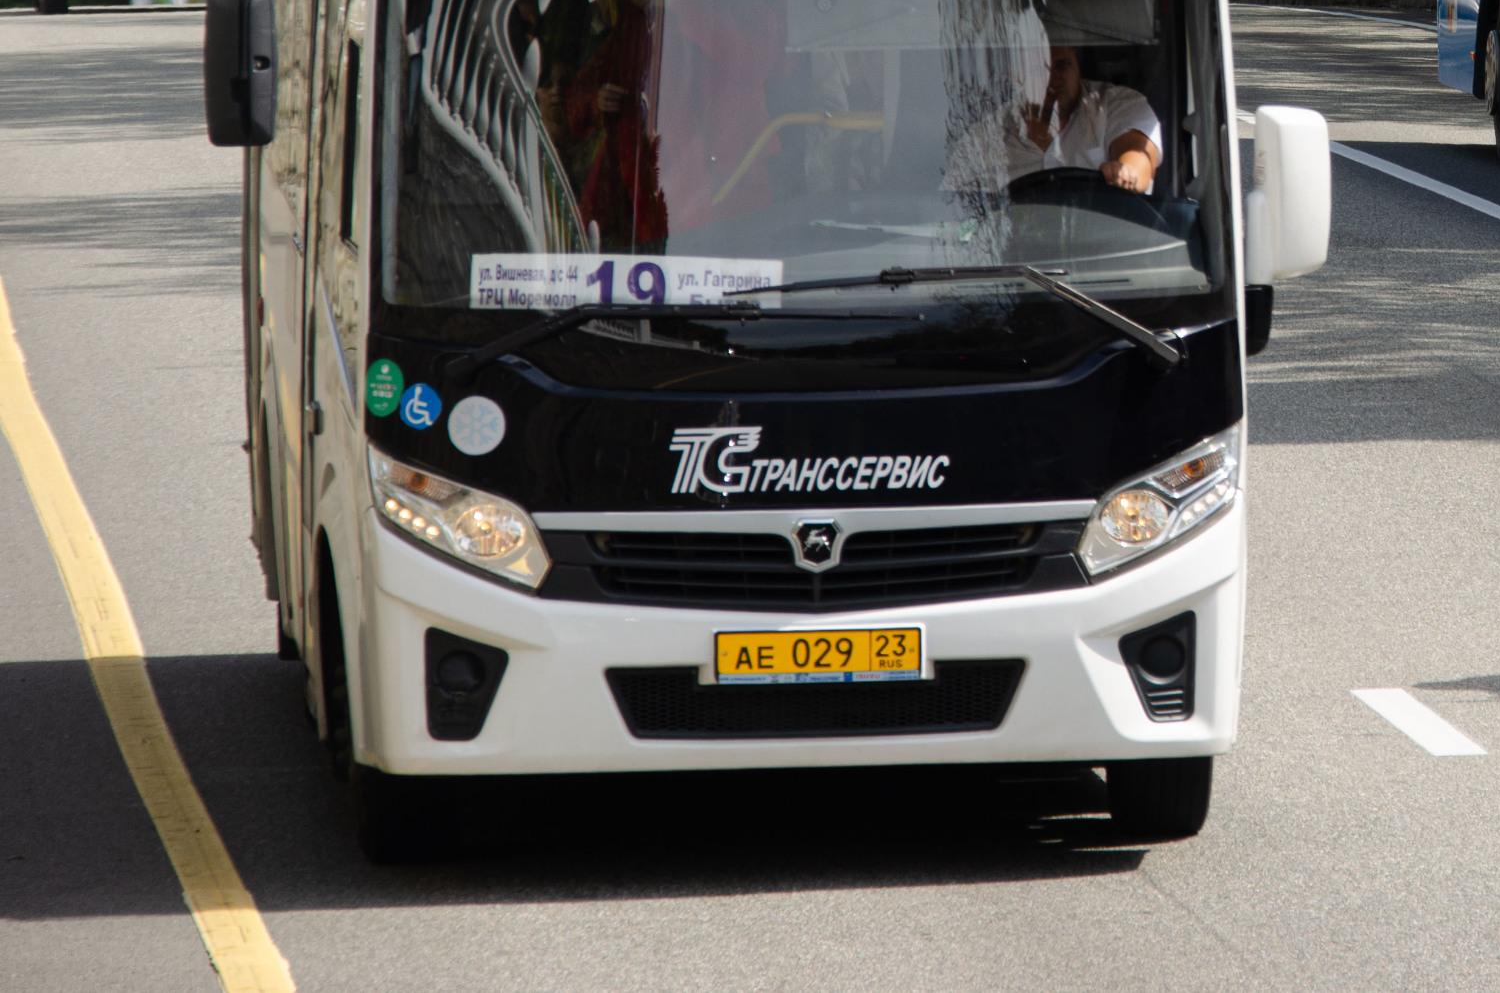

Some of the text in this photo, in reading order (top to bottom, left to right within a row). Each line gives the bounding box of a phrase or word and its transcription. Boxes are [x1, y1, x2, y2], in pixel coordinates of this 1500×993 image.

[586, 260, 666, 304] 19
[677, 270, 771, 289] ул. Гагарина
[478, 288, 504, 306] ТРЦ
[750, 455, 950, 492] ТРАНССЕРВИС
[792, 638, 854, 668] 029
[875, 634, 906, 658] 23
[879, 659, 903, 668] RUS
